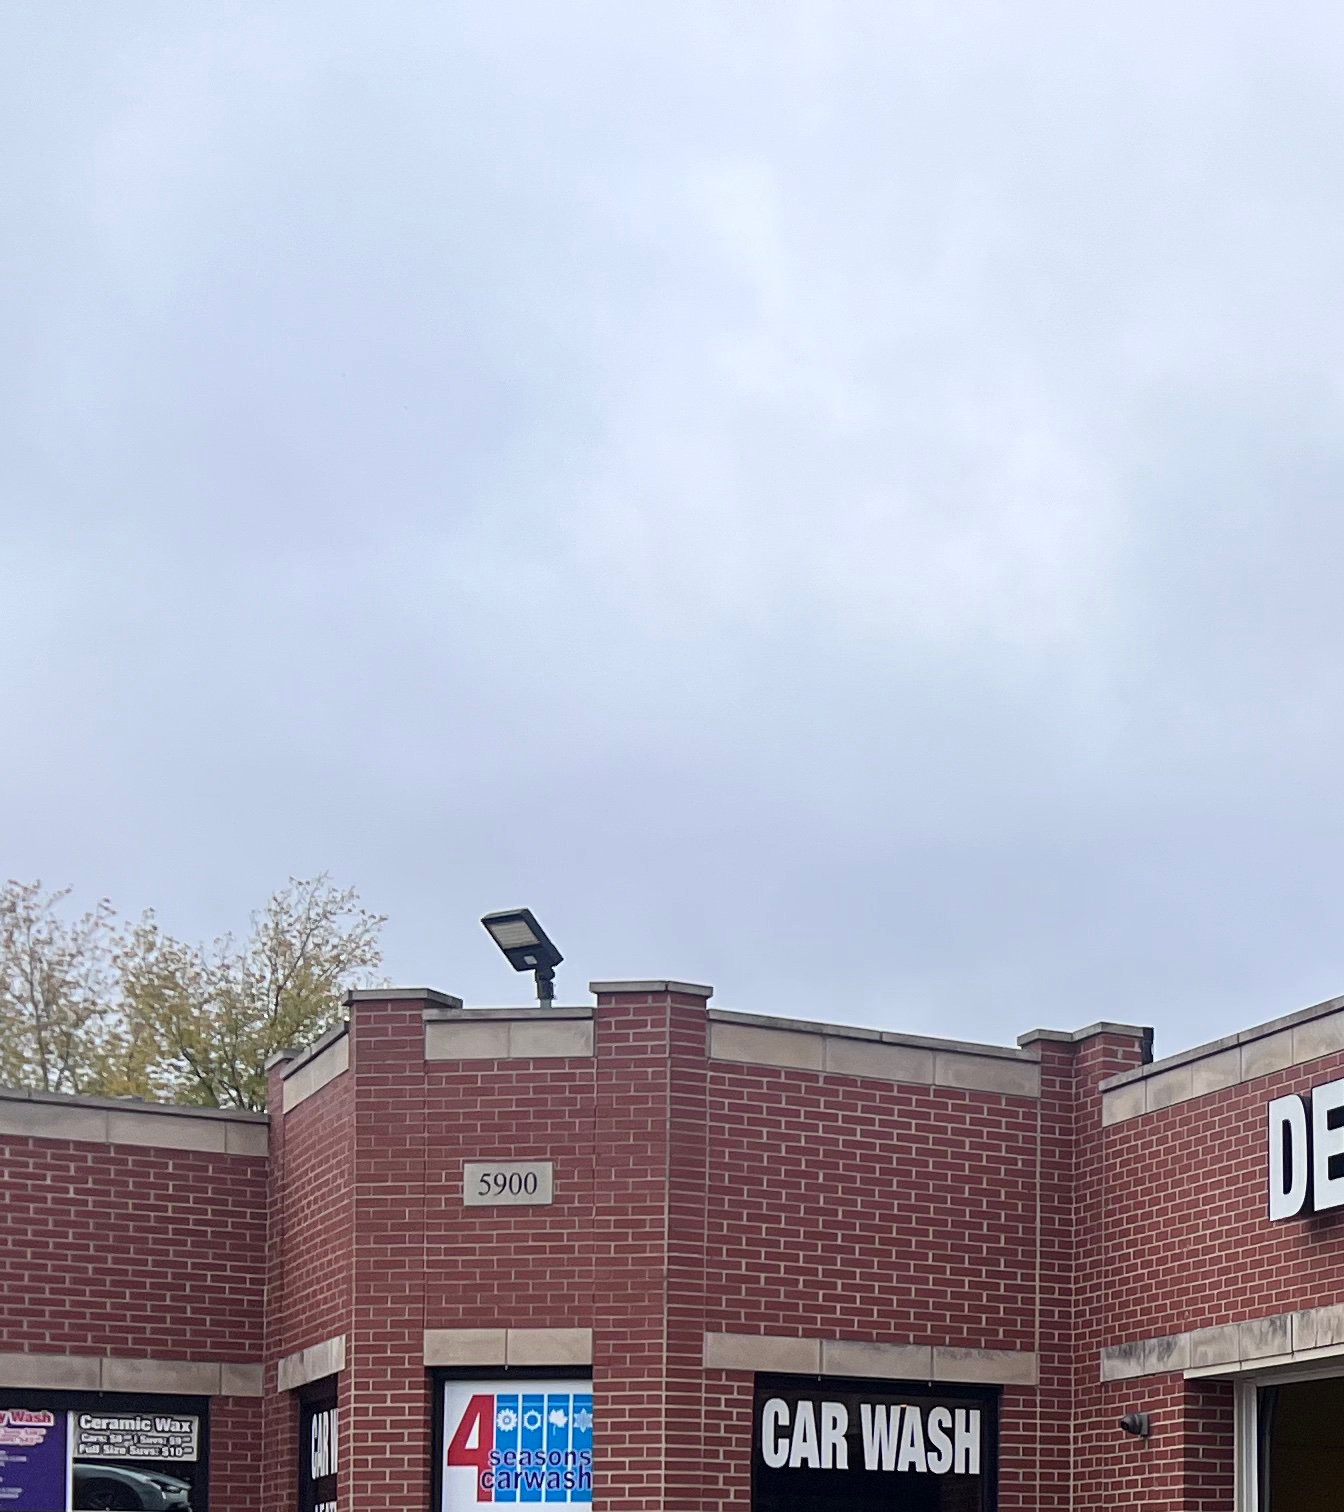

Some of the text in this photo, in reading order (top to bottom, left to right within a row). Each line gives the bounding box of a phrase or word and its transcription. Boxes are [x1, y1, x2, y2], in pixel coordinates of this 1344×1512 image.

[478, 1172, 538, 1196] 5900
[80, 1414, 191, 1432] Ceramic Wax
[312, 1410, 329, 1480] CAR
[447, 1394, 495, 1503] 4
[762, 1398, 981, 1474] CAR WASH
[489, 1449, 591, 1466] seasons
[481, 1464, 592, 1489] carwash
